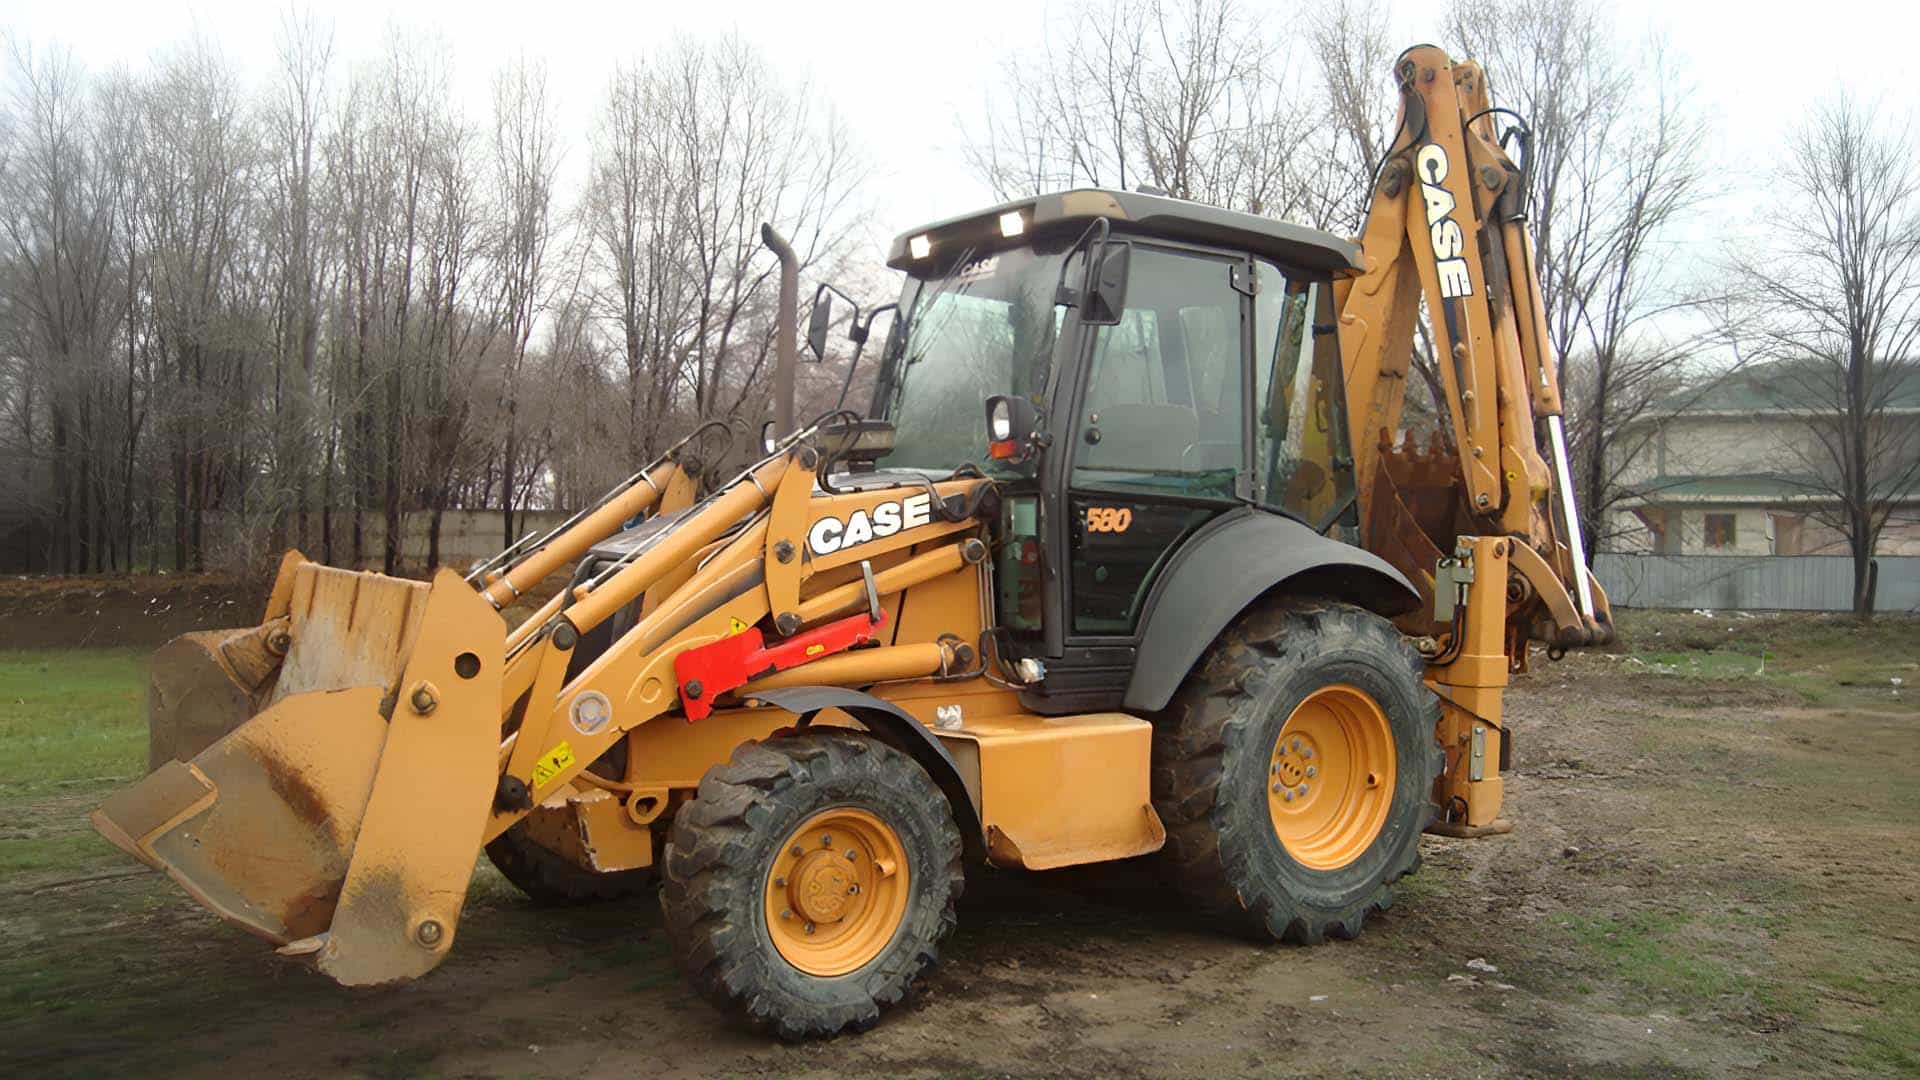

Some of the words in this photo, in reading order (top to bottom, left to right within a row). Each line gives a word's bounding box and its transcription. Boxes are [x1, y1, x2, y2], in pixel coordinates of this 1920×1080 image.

[1417, 144, 1473, 298] CASE
[808, 492, 931, 555] CASE
[1087, 507, 1132, 532] 580
